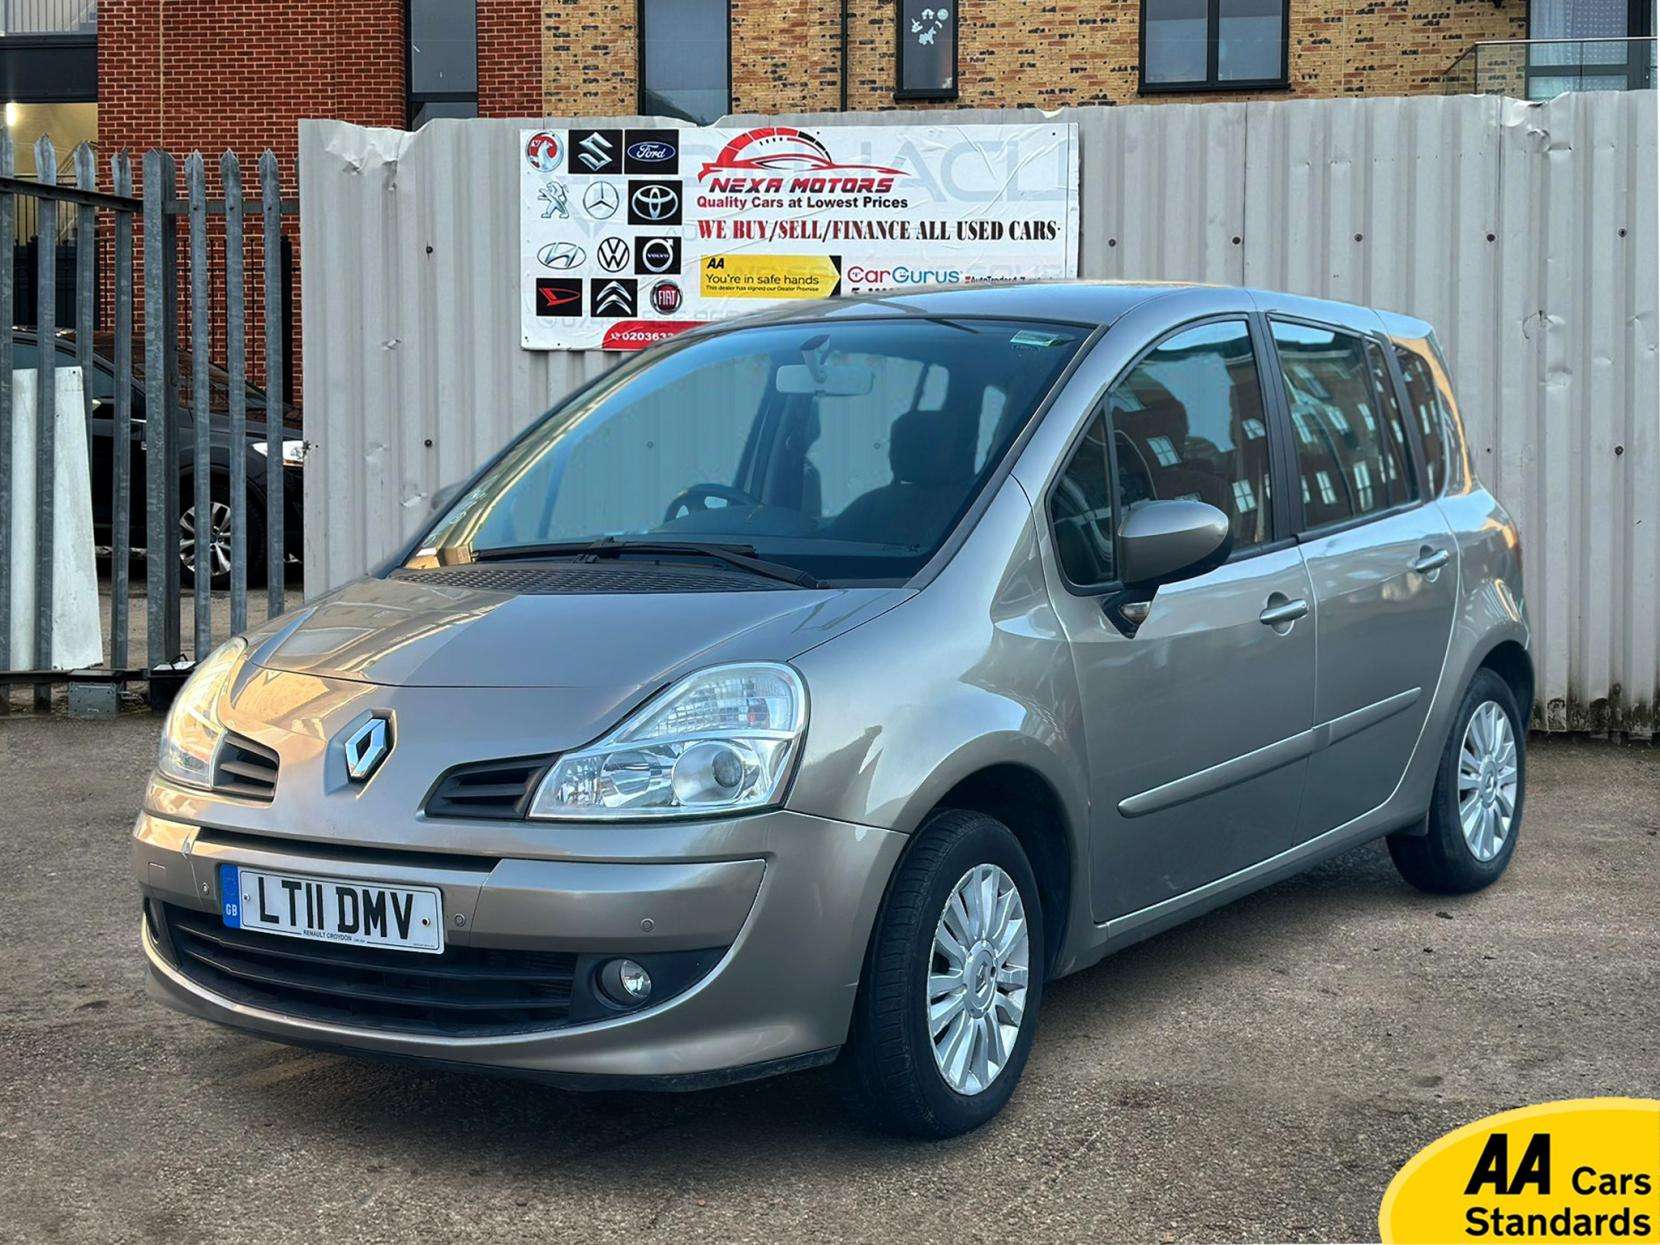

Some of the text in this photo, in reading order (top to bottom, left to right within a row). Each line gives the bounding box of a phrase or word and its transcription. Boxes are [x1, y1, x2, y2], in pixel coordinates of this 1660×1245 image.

[636, 144, 666, 158] Ford
[709, 177, 894, 193] NEXA MOTORS
[697, 196, 909, 209] Quality Cars at Lowest Prices
[697, 220, 727, 239] WE
[733, 220, 911, 242] BUY/SELL/FINANCE
[916, 221, 951, 240] ALL
[957, 220, 1004, 240] USED
[706, 257, 725, 269] AA
[706, 274, 819, 285] You're in safe hands
[847, 266, 960, 283] CarGurus
[658, 290, 676, 306] FIAT
[226, 903, 237, 916] GB
[335, 886, 414, 940] DMV
[303, 930, 326, 939] RENAULT
